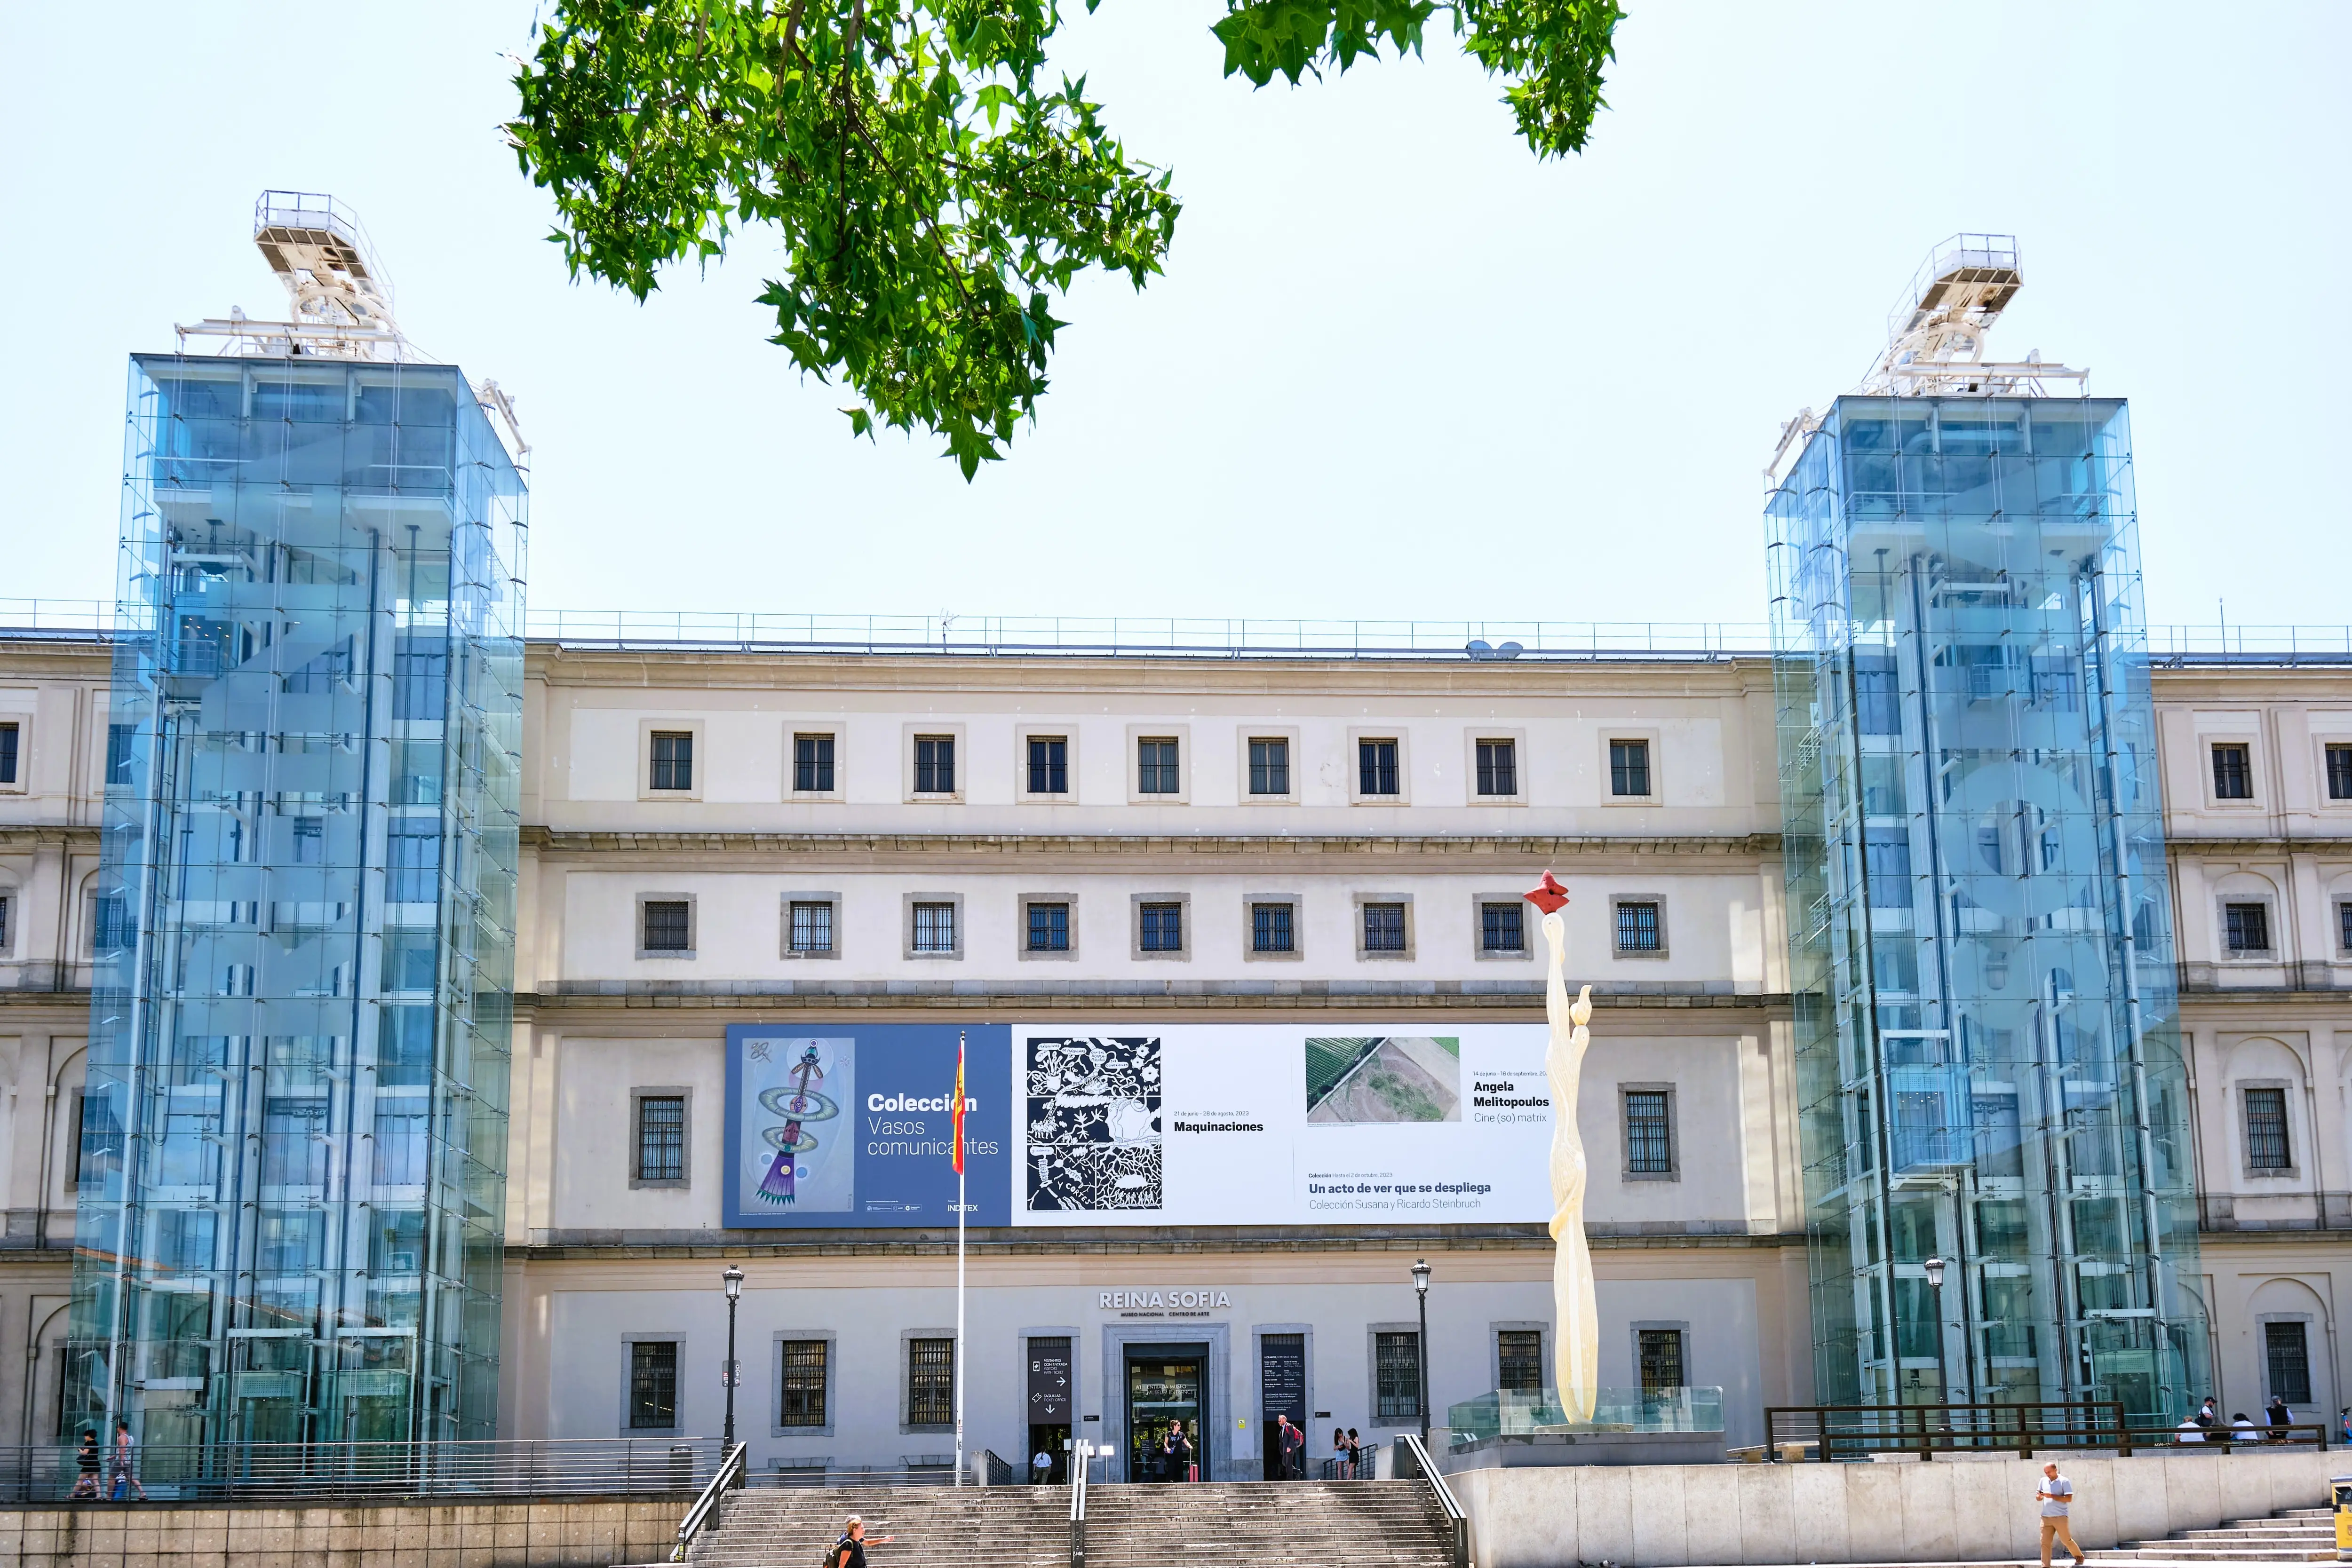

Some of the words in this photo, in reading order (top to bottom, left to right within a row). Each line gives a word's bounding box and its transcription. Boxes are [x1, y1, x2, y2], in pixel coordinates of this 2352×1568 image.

[1474, 1081, 1514, 1093] Angela
[1474, 1097, 1549, 1109] Melitopoulos
[1474, 1113, 1495, 1122] Cine
[1497, 1113, 1515, 1124] (so)
[1518, 1113, 1547, 1122] matrix
[868, 1117, 924, 1135] Vasos
[1175, 1122, 1263, 1133] Maquinaciones
[1057, 1181, 1064, 1190] Y
[1065, 1182, 1091, 1204] CORTES
[1309, 1184, 1325, 1193] Un
[1328, 1184, 1354, 1193] acto
[1357, 1183, 1371, 1193] de
[1395, 1185, 1416, 1195] que
[1435, 1182, 1491, 1195] despliega
[1310, 1199, 1353, 1209] Colección
[1355, 1199, 1388, 1209] Susana
[1391, 1202, 1395, 1211] y
[1397, 1199, 1430, 1208] Ricardo
[1432, 1198, 1480, 1208] Steinbruch
[1099, 1291, 1164, 1308] REINA
[1168, 1291, 1232, 1308] SOFIA
